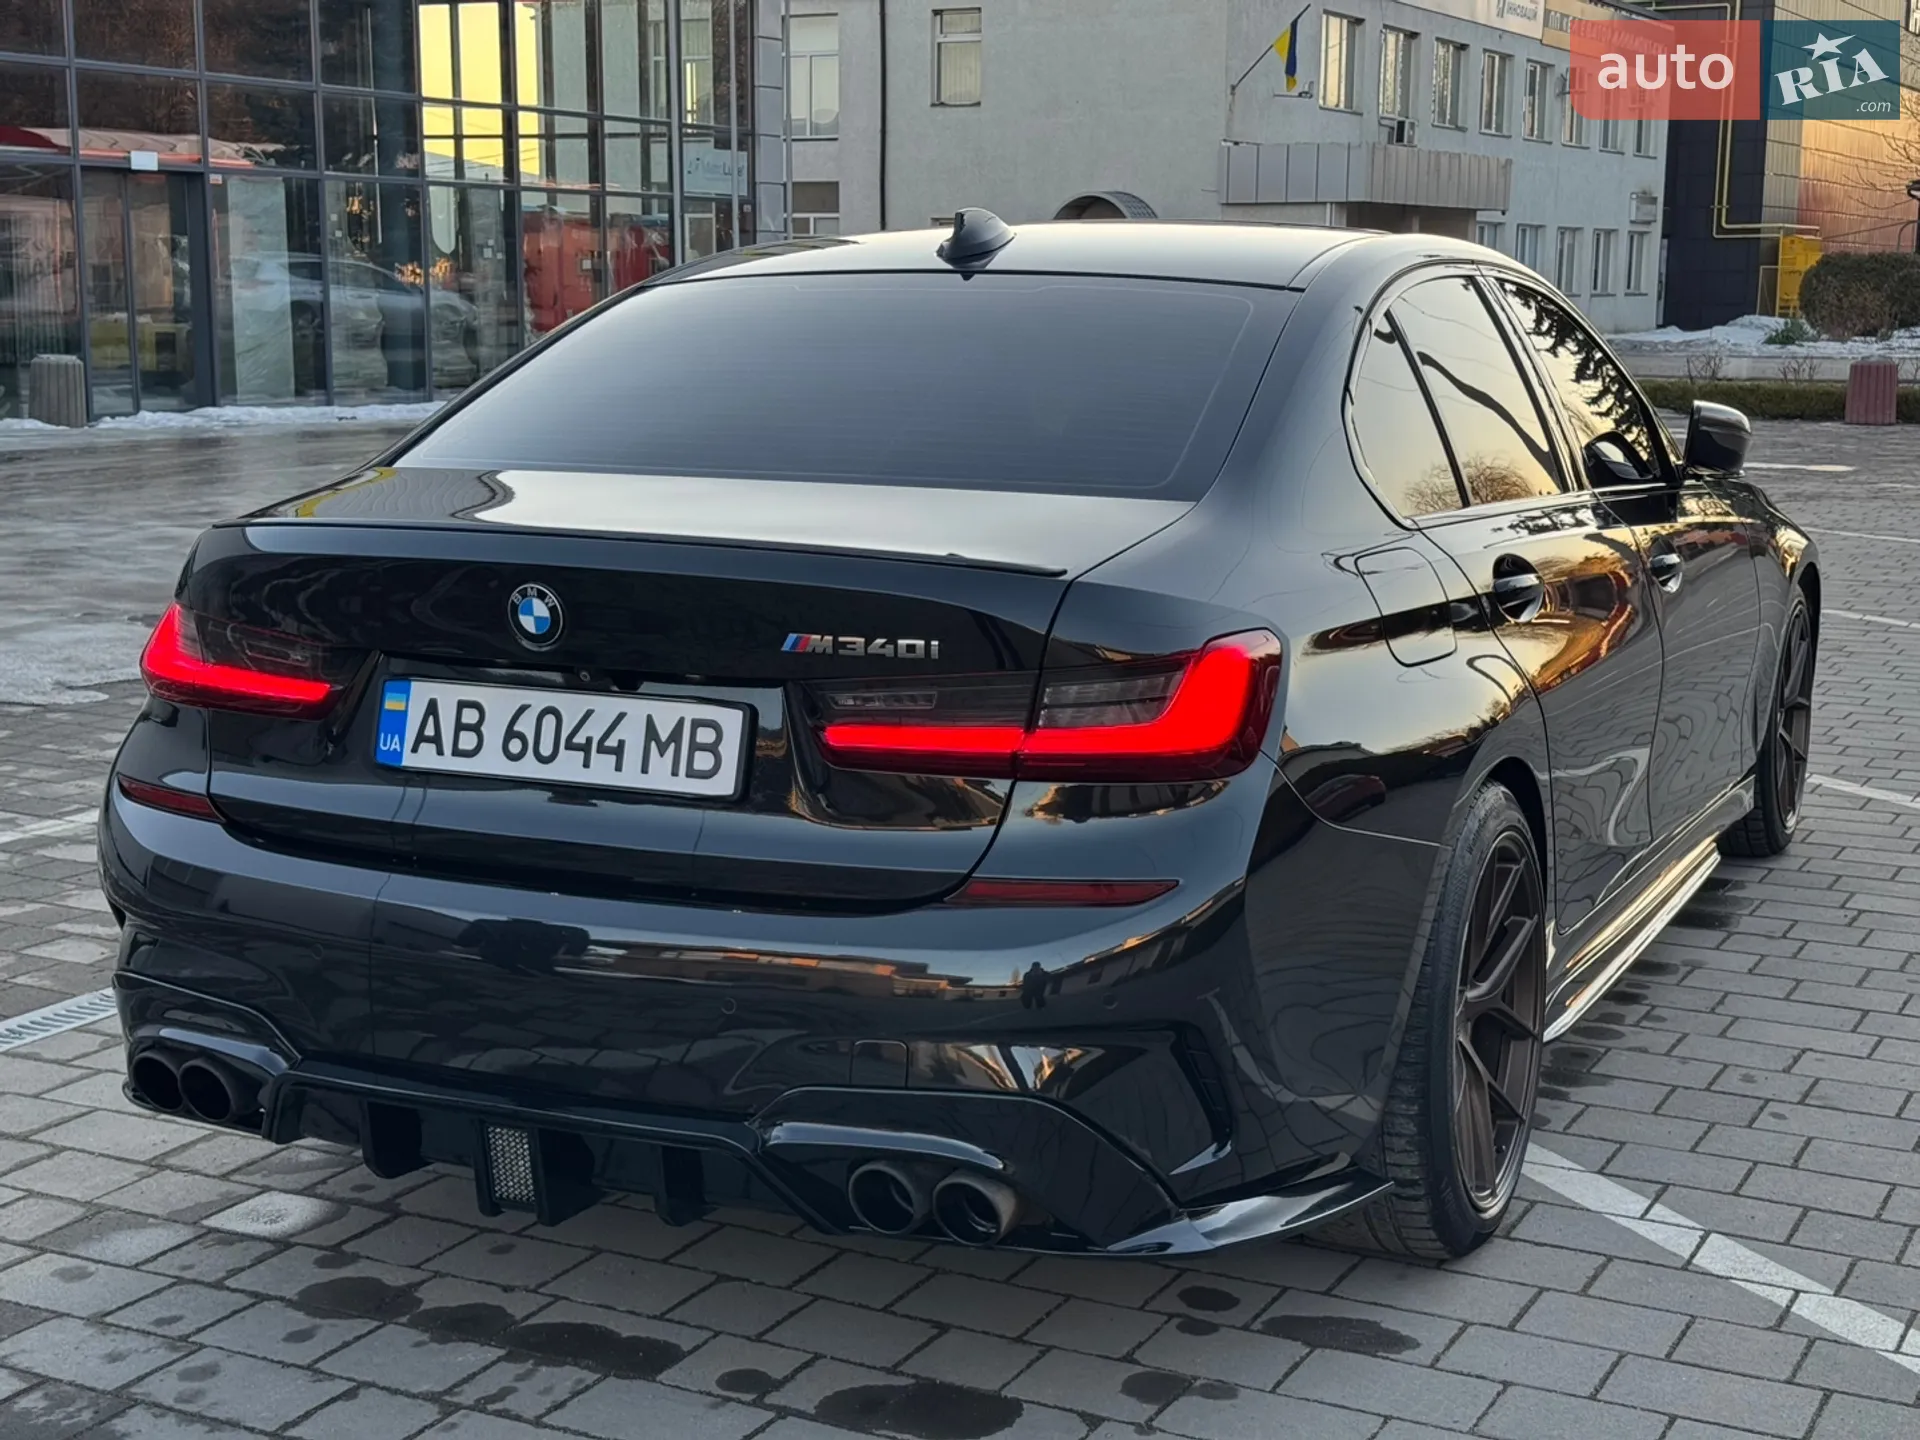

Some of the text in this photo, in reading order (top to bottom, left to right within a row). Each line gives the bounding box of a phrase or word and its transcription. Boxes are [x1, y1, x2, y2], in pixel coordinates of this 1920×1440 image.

[510, 586, 556, 608] BMW
[808, 634, 939, 659] M340i
[379, 732, 401, 752] UA
[410, 697, 725, 780] AB 6044 MB
